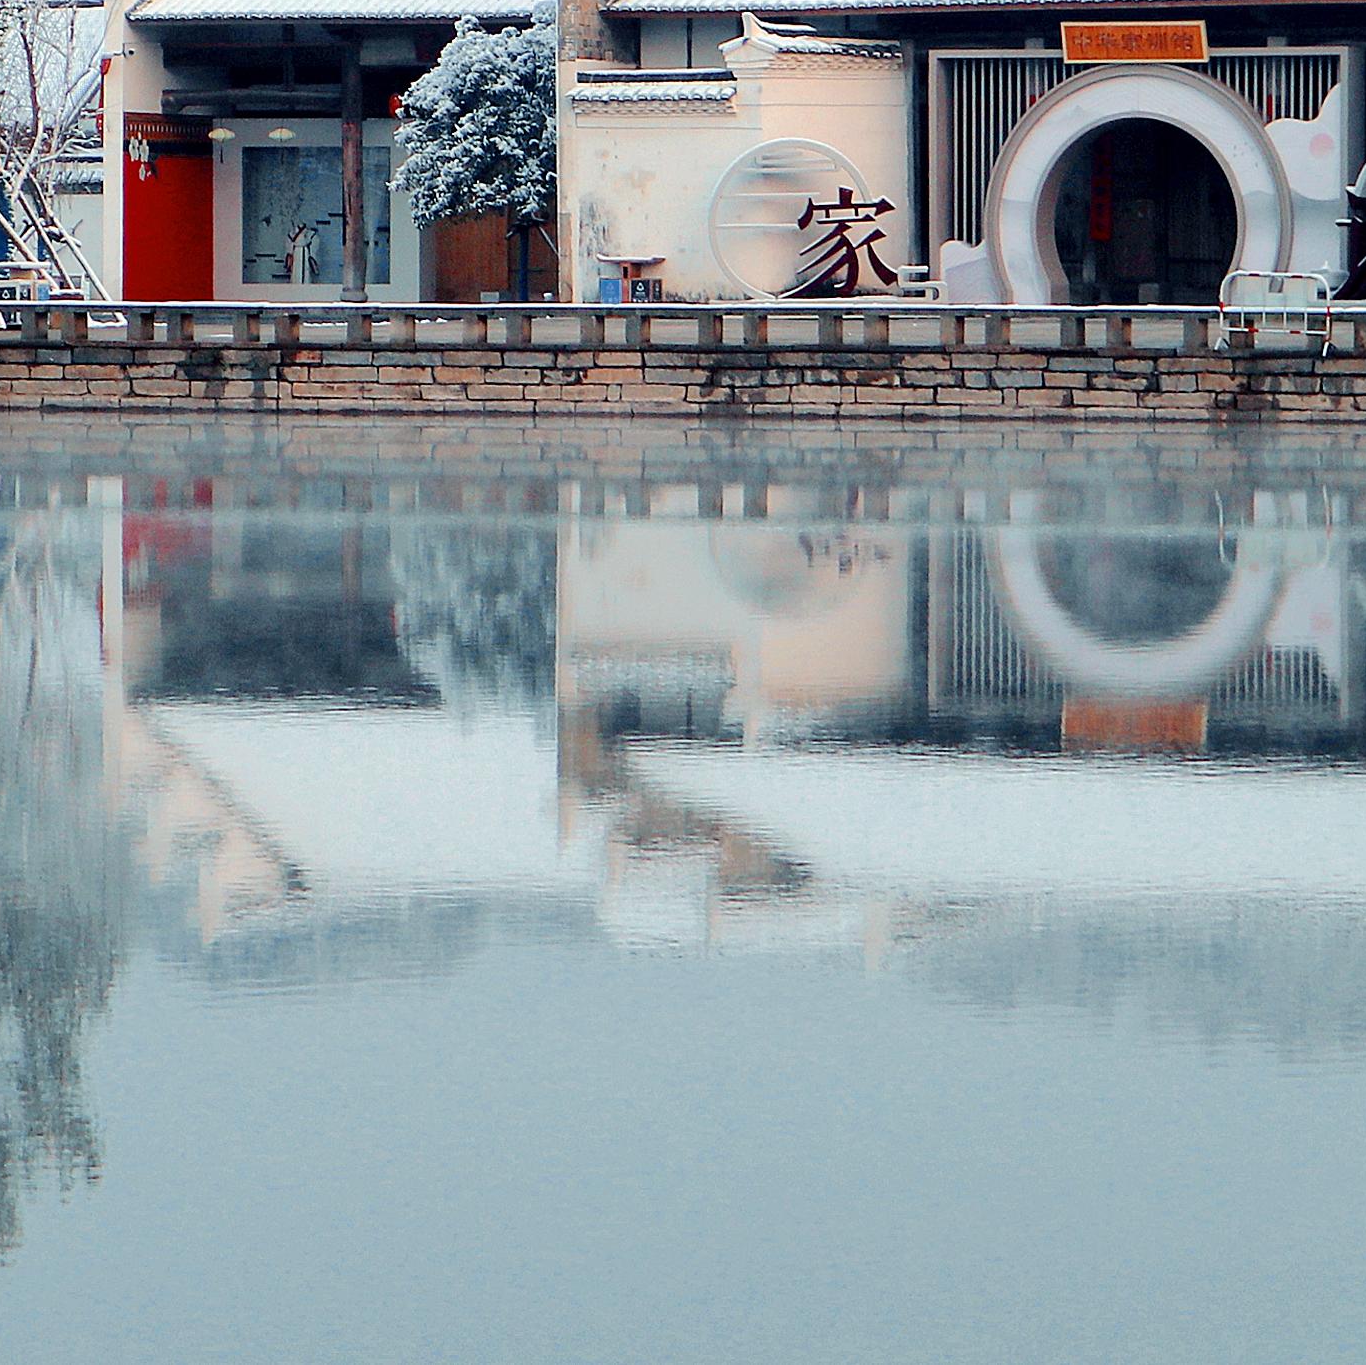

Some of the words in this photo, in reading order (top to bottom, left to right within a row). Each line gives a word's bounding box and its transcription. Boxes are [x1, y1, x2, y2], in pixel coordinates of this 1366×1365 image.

[1072, 32, 1194, 54] 中华家训馆
[777, 185, 898, 298] 家
